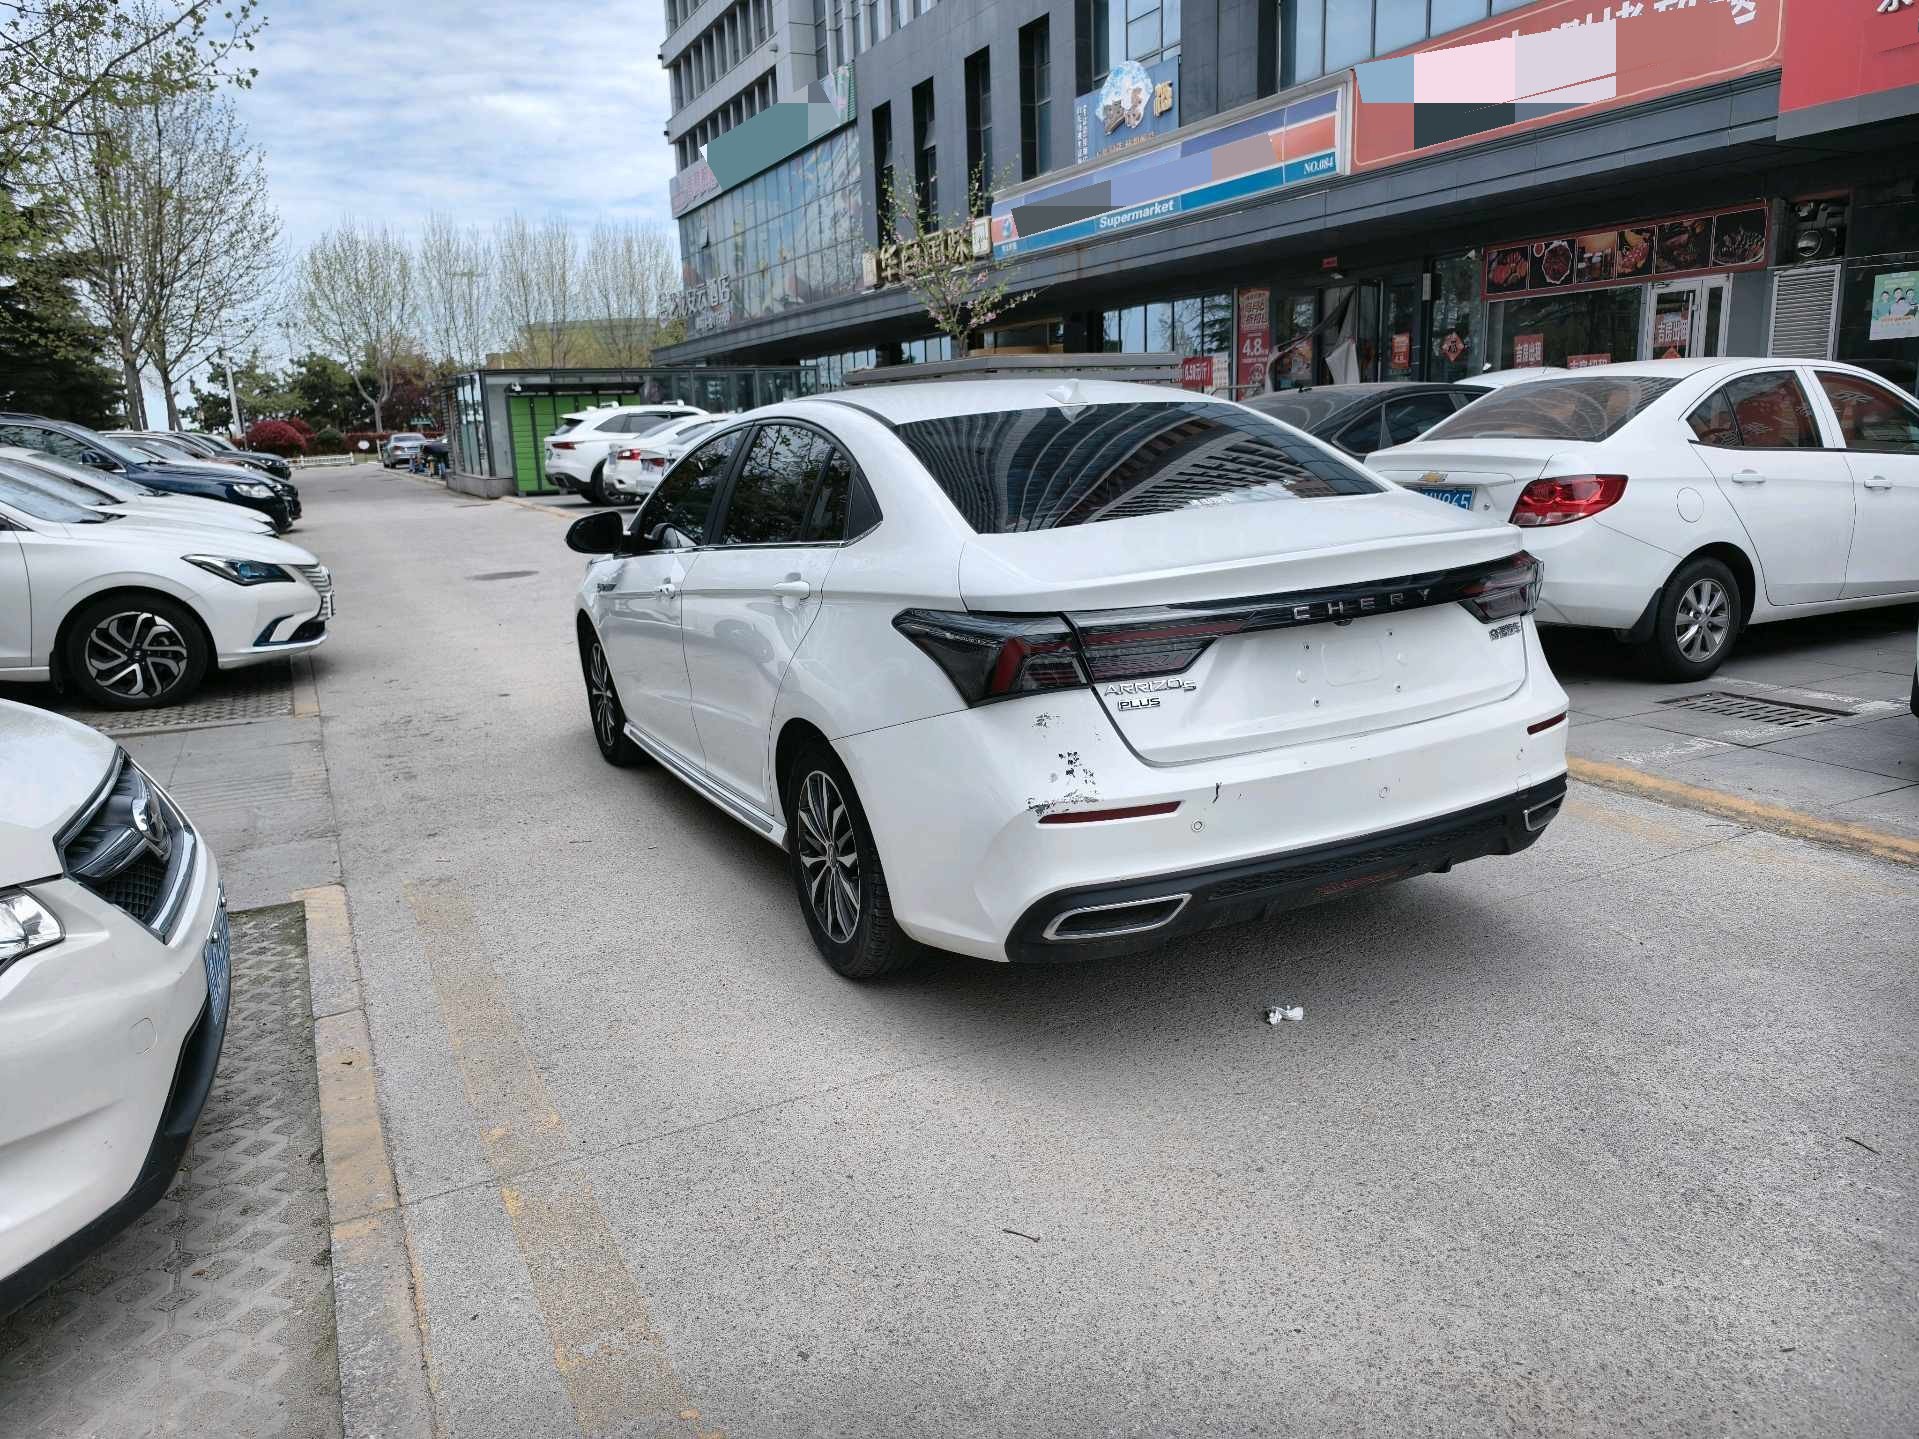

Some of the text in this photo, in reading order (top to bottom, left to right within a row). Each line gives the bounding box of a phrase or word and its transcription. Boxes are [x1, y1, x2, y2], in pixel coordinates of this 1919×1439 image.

[1099, 200, 1174, 228] Supermarket
[1242, 337, 1263, 356] 4.8
[1293, 588, 1431, 620] CHERY
[1118, 697, 1161, 712] PLUS
